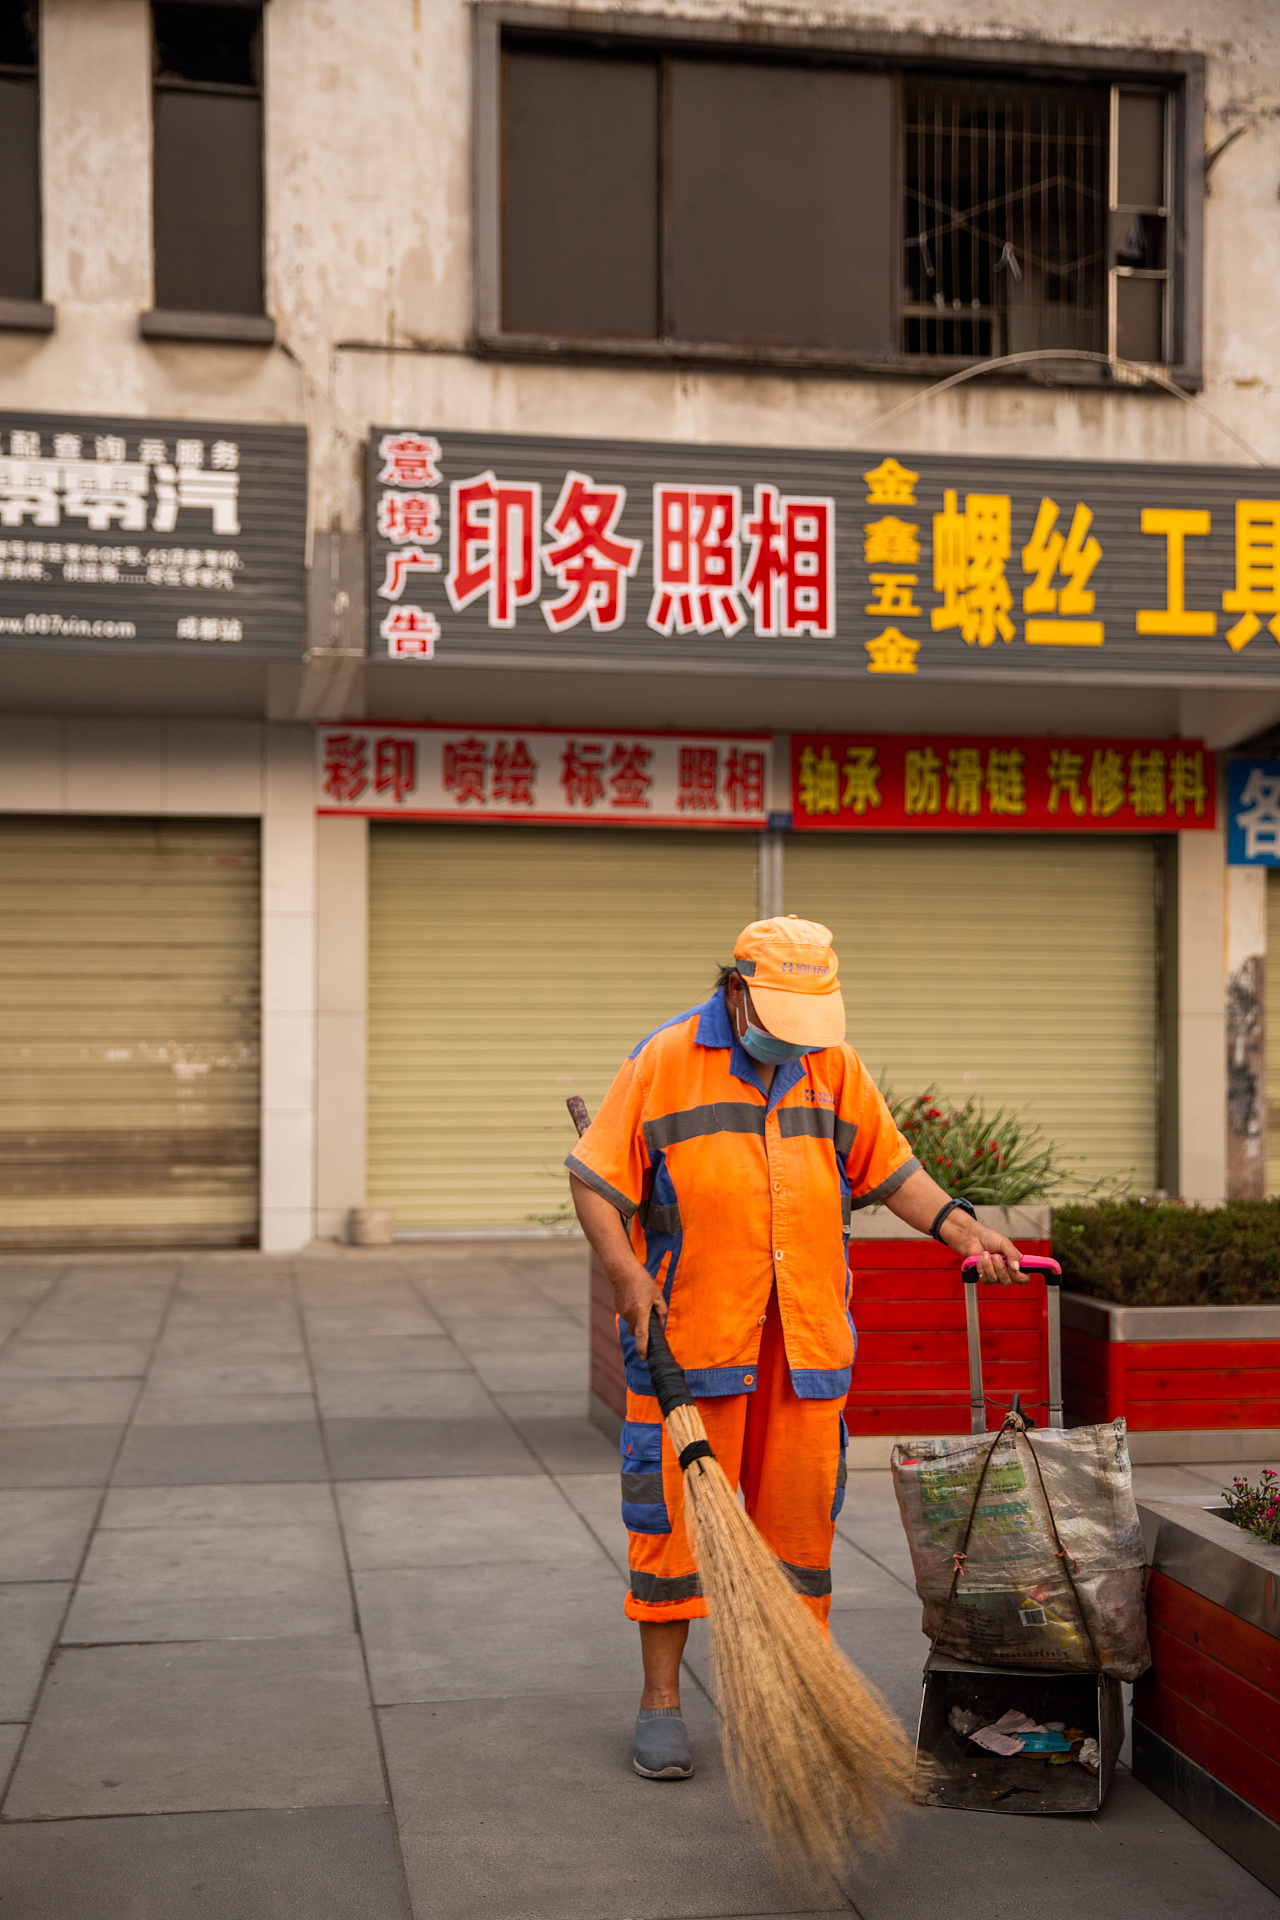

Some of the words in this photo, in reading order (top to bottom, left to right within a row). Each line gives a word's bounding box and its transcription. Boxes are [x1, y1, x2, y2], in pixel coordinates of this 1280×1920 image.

[378, 433, 443, 659] 意境广告
[445, 470, 836, 638] 印务照相
[863, 457, 922, 674] 金鑫五金
[930, 488, 1105, 648] 螺丝
[322, 733, 418, 802] 彩印
[442, 738, 537, 806] 喷绘
[560, 740, 655, 809] 标签
[675, 745, 767, 811] 照相
[799, 744, 882, 815] 轴承
[904, 746, 1026, 816] 防滑链
[1047, 748, 1208, 817] 汽修辅料
